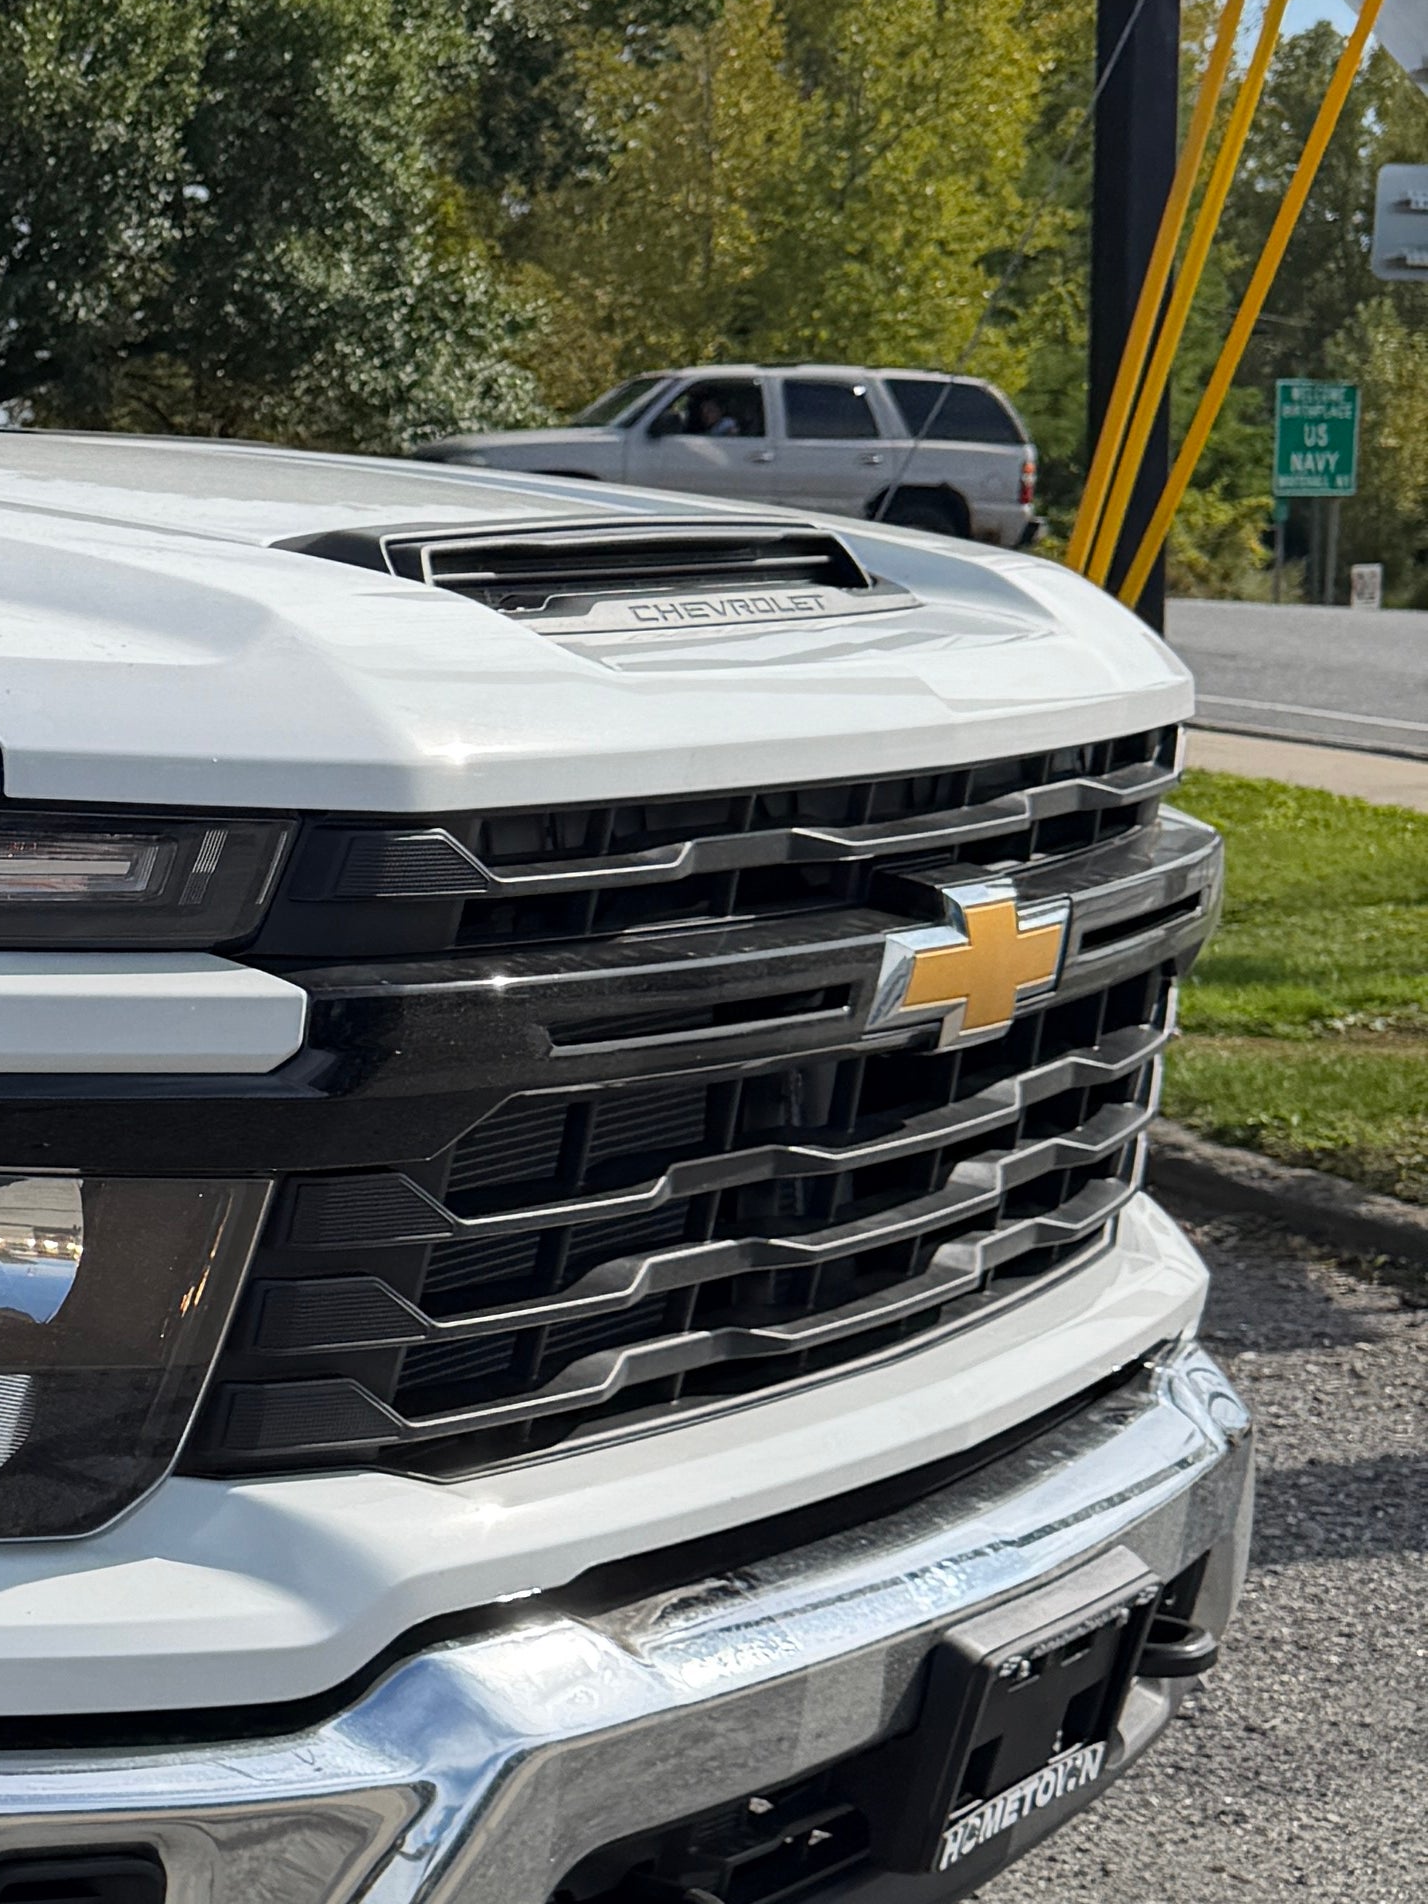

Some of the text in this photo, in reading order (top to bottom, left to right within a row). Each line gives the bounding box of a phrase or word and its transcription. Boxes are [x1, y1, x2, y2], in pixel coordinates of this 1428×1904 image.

[1303, 422, 1329, 448] US
[1289, 450, 1341, 474] NAVY
[628, 593, 825, 622] CHEVROLET
